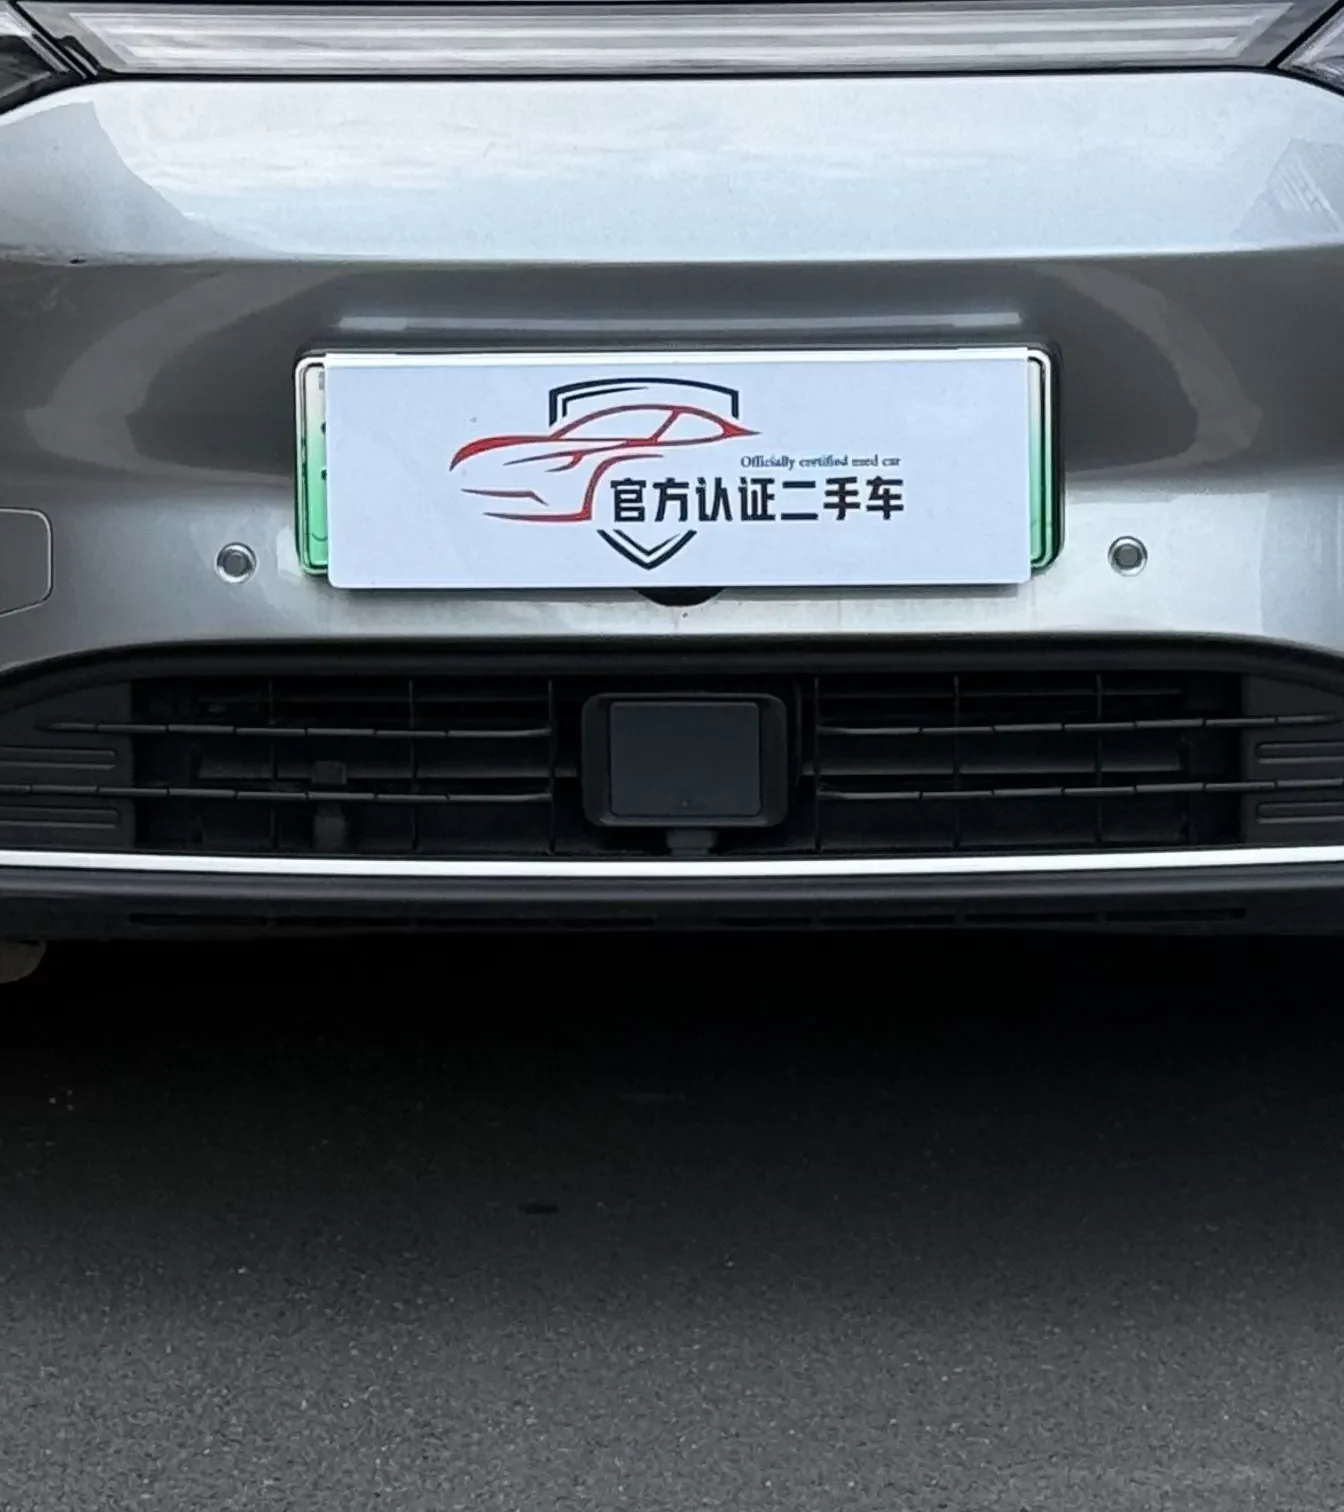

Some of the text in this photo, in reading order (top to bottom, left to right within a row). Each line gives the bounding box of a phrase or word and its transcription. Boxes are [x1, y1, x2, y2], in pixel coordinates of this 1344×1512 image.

[740, 455, 795, 471] Officially
[798, 454, 848, 468] certified
[882, 457, 901, 467] car
[610, 476, 904, 522] 官方认证二手车
